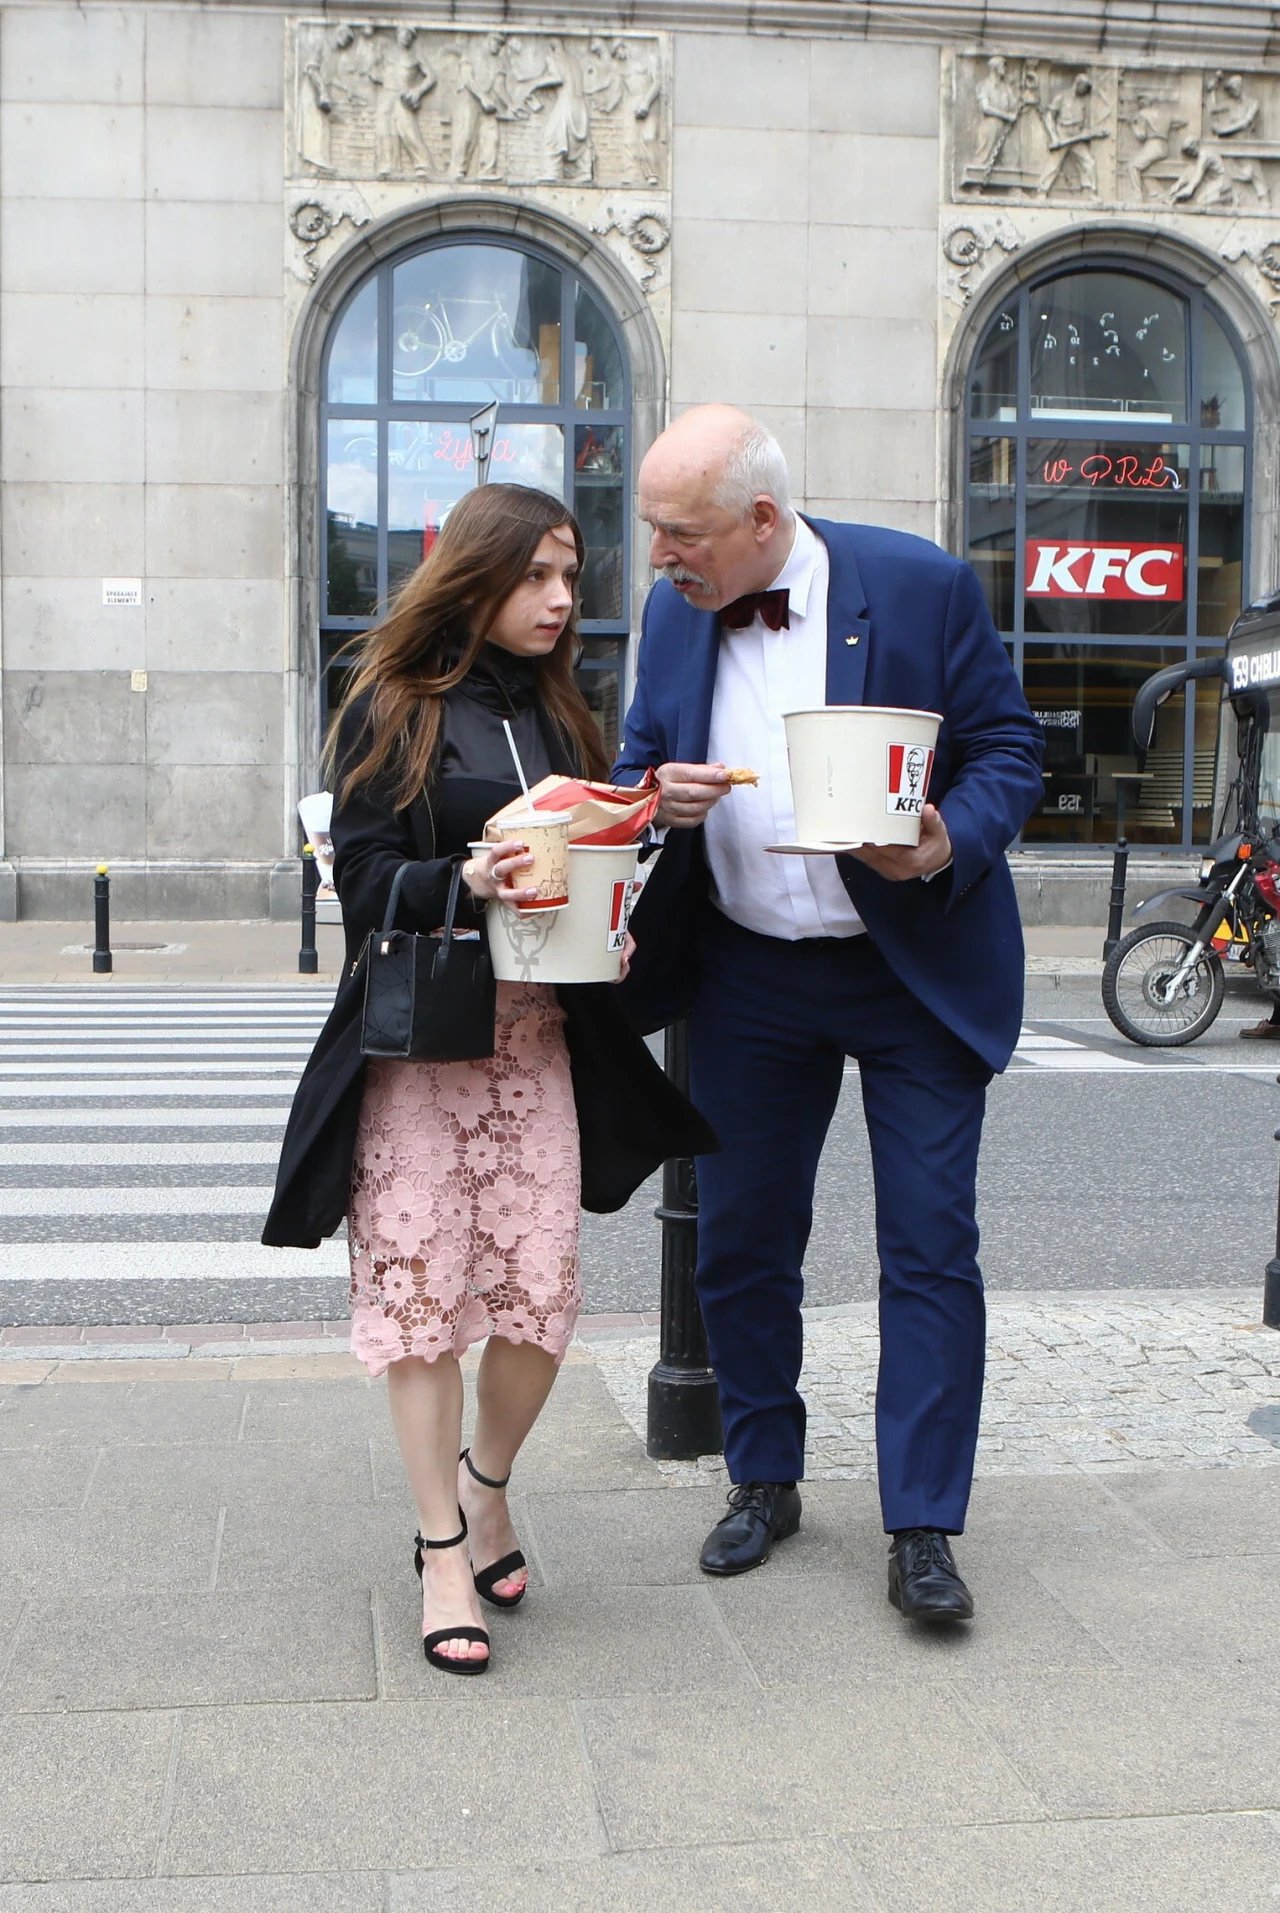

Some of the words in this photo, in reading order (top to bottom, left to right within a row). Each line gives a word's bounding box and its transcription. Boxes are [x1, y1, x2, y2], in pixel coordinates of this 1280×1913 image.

[434, 430, 517, 471] Żya
[1081, 455, 1169, 487] PRL
[1026, 546, 1173, 596] KFC
[1232, 654, 1249, 690] 159
[894, 797, 923, 813] KFC
[612, 932, 626, 948] KF
